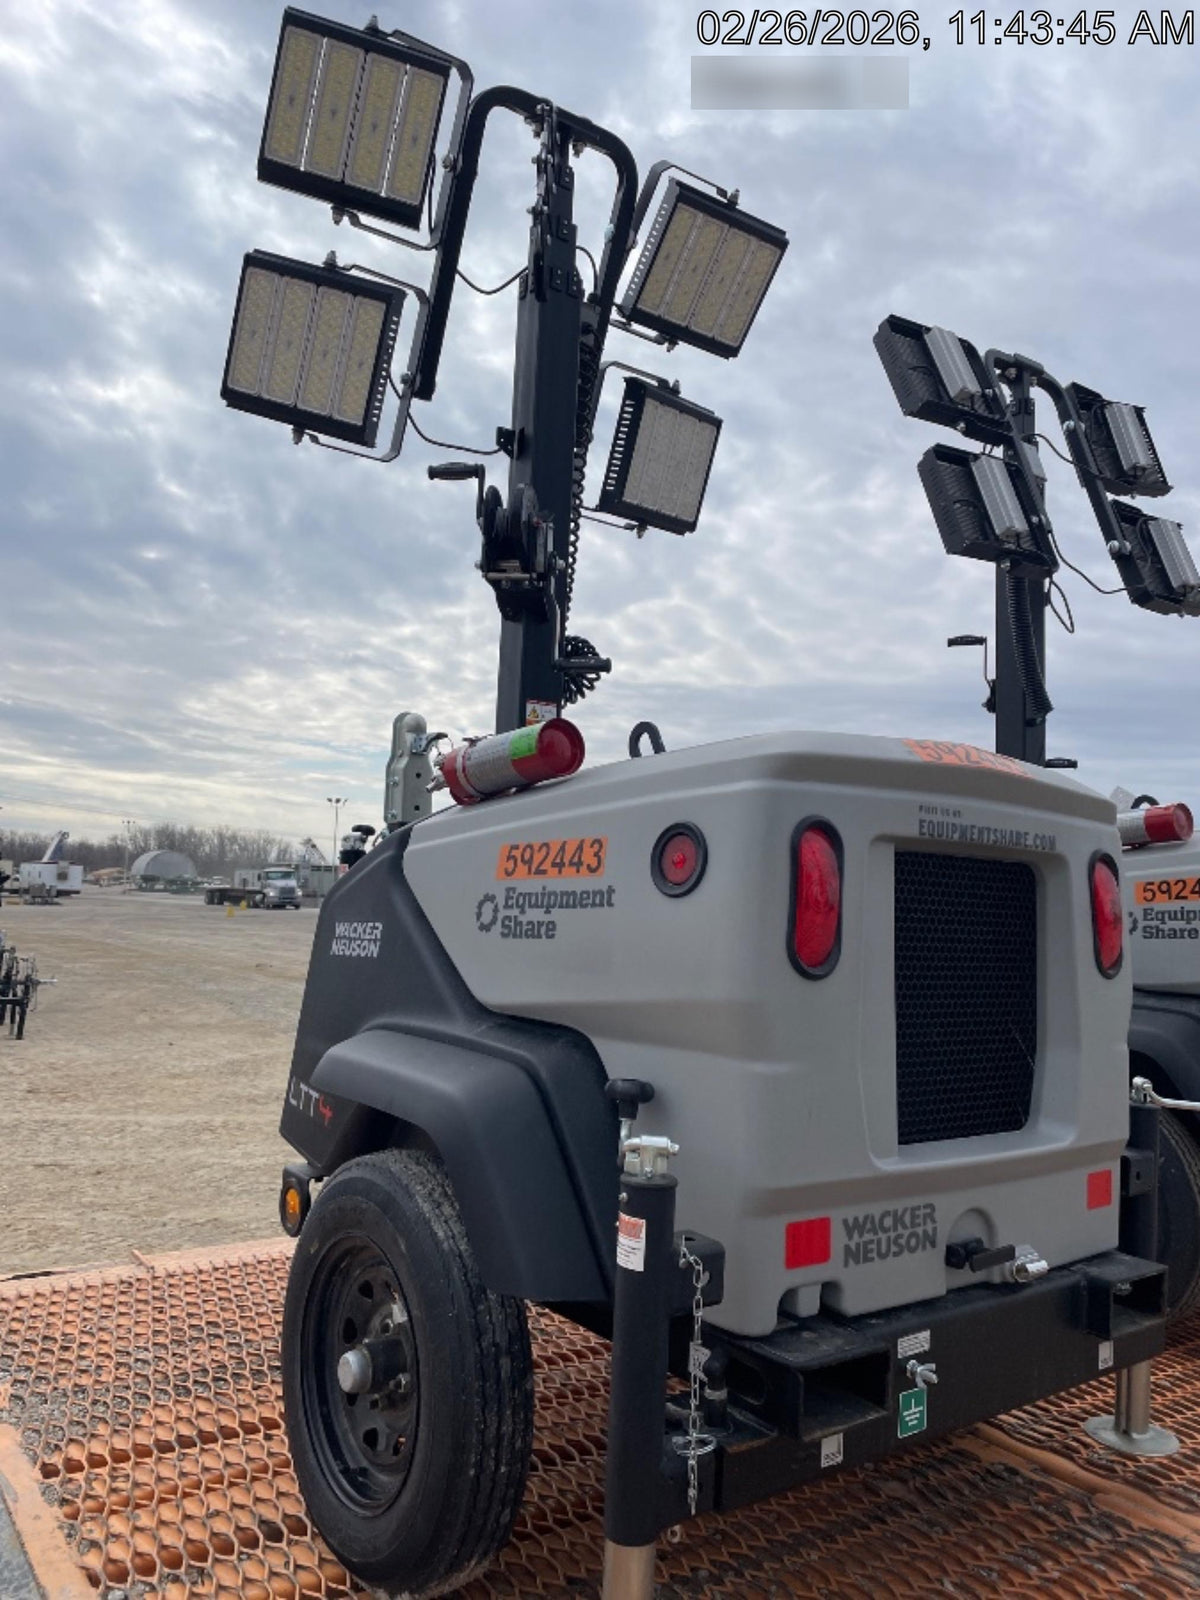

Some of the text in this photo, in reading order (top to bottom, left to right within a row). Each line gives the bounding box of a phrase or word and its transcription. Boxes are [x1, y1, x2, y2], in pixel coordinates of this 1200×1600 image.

[909, 740, 1031, 777] 592
[918, 819, 1057, 850] EQUIPMENTSHARE.COM
[504, 838, 604, 877] 592443
[503, 886, 616, 915] Equipment
[335, 921, 383, 939] WACKER
[500, 915, 557, 939] Share
[1142, 906, 1200, 925] Equip
[1142, 925, 1200, 939] Share
[330, 938, 381, 957] NEUSON
[842, 1203, 937, 1241] WACKER
[844, 1226, 938, 1268] NEUSON
